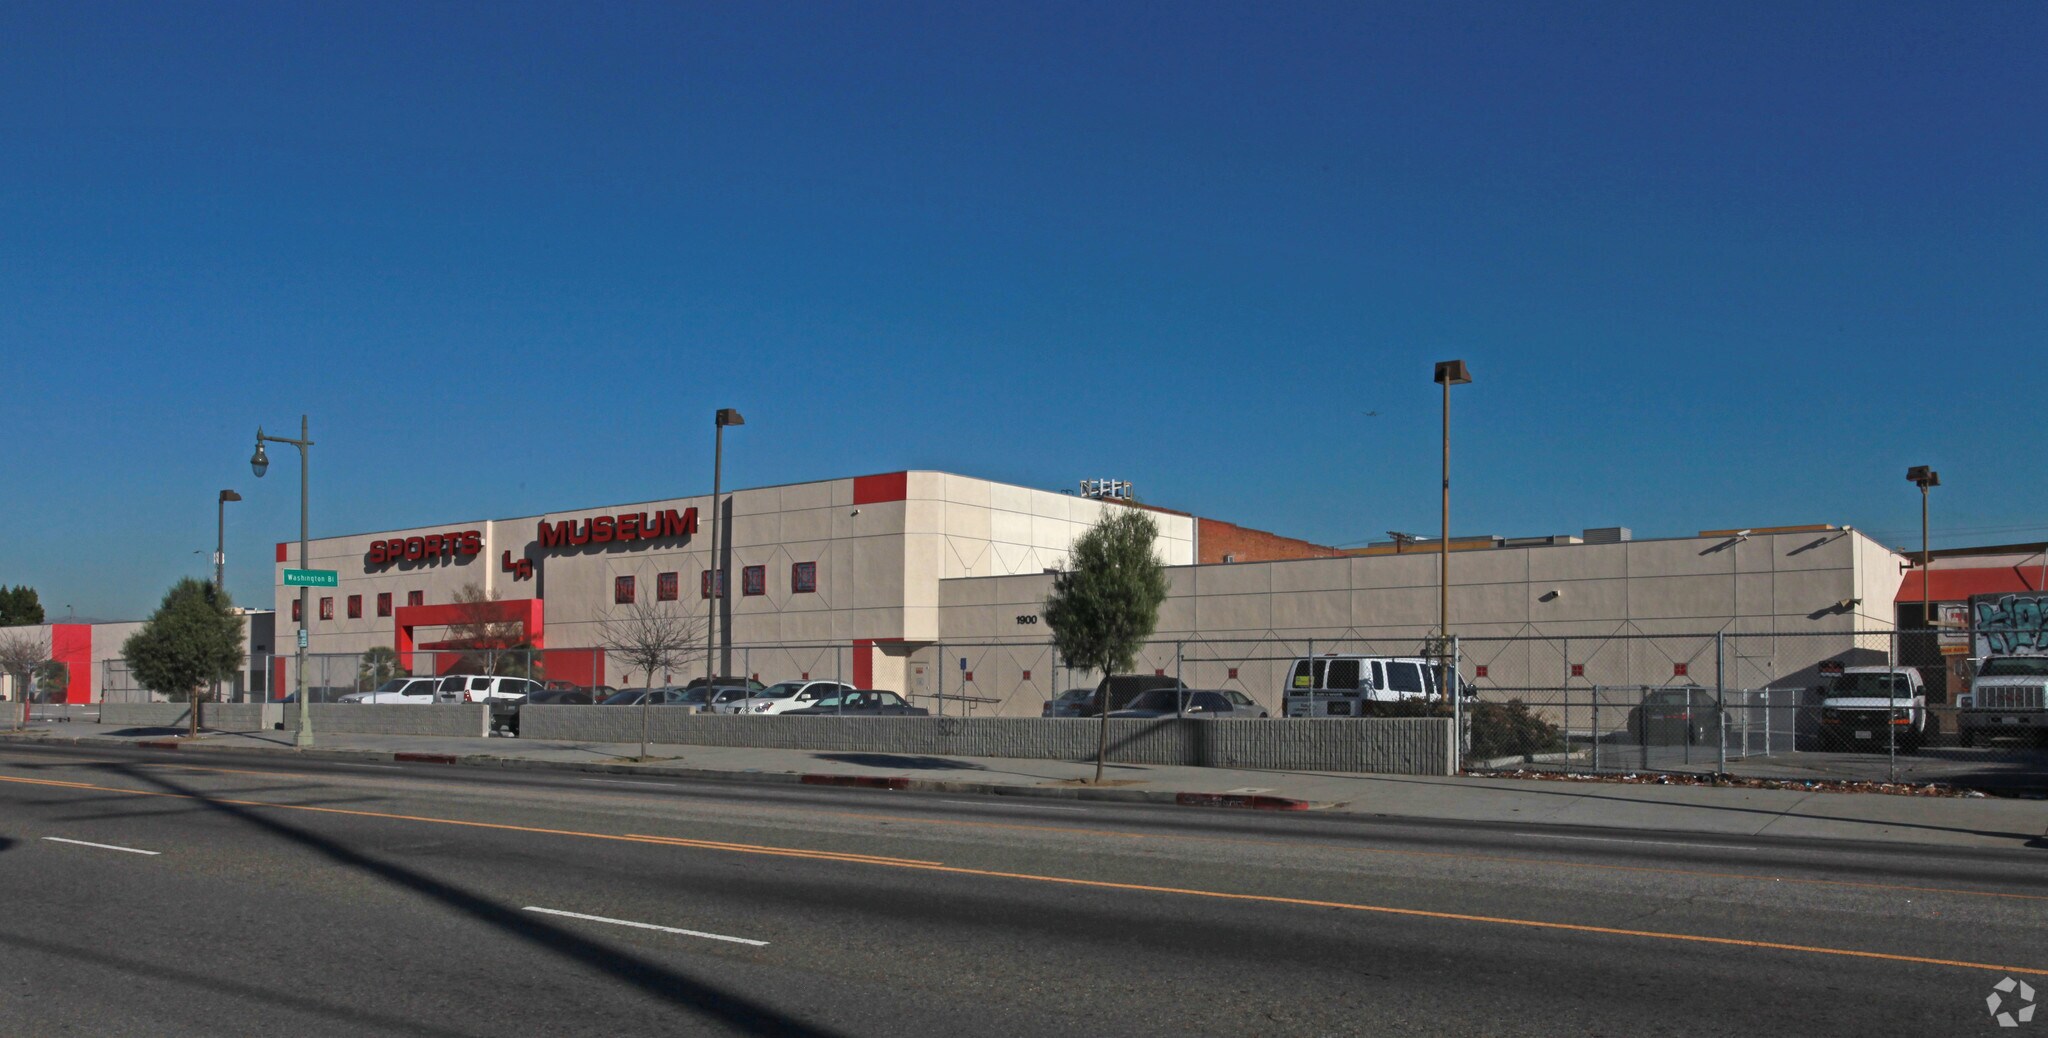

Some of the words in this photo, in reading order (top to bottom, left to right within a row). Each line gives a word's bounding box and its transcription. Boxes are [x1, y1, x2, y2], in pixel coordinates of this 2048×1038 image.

[539, 507, 698, 548] MUSEUM
[370, 530, 481, 563] SPORTS
[504, 550, 532, 578] LA
[287, 574, 325, 583] Washington
[1016, 615, 1037, 625] 1900
